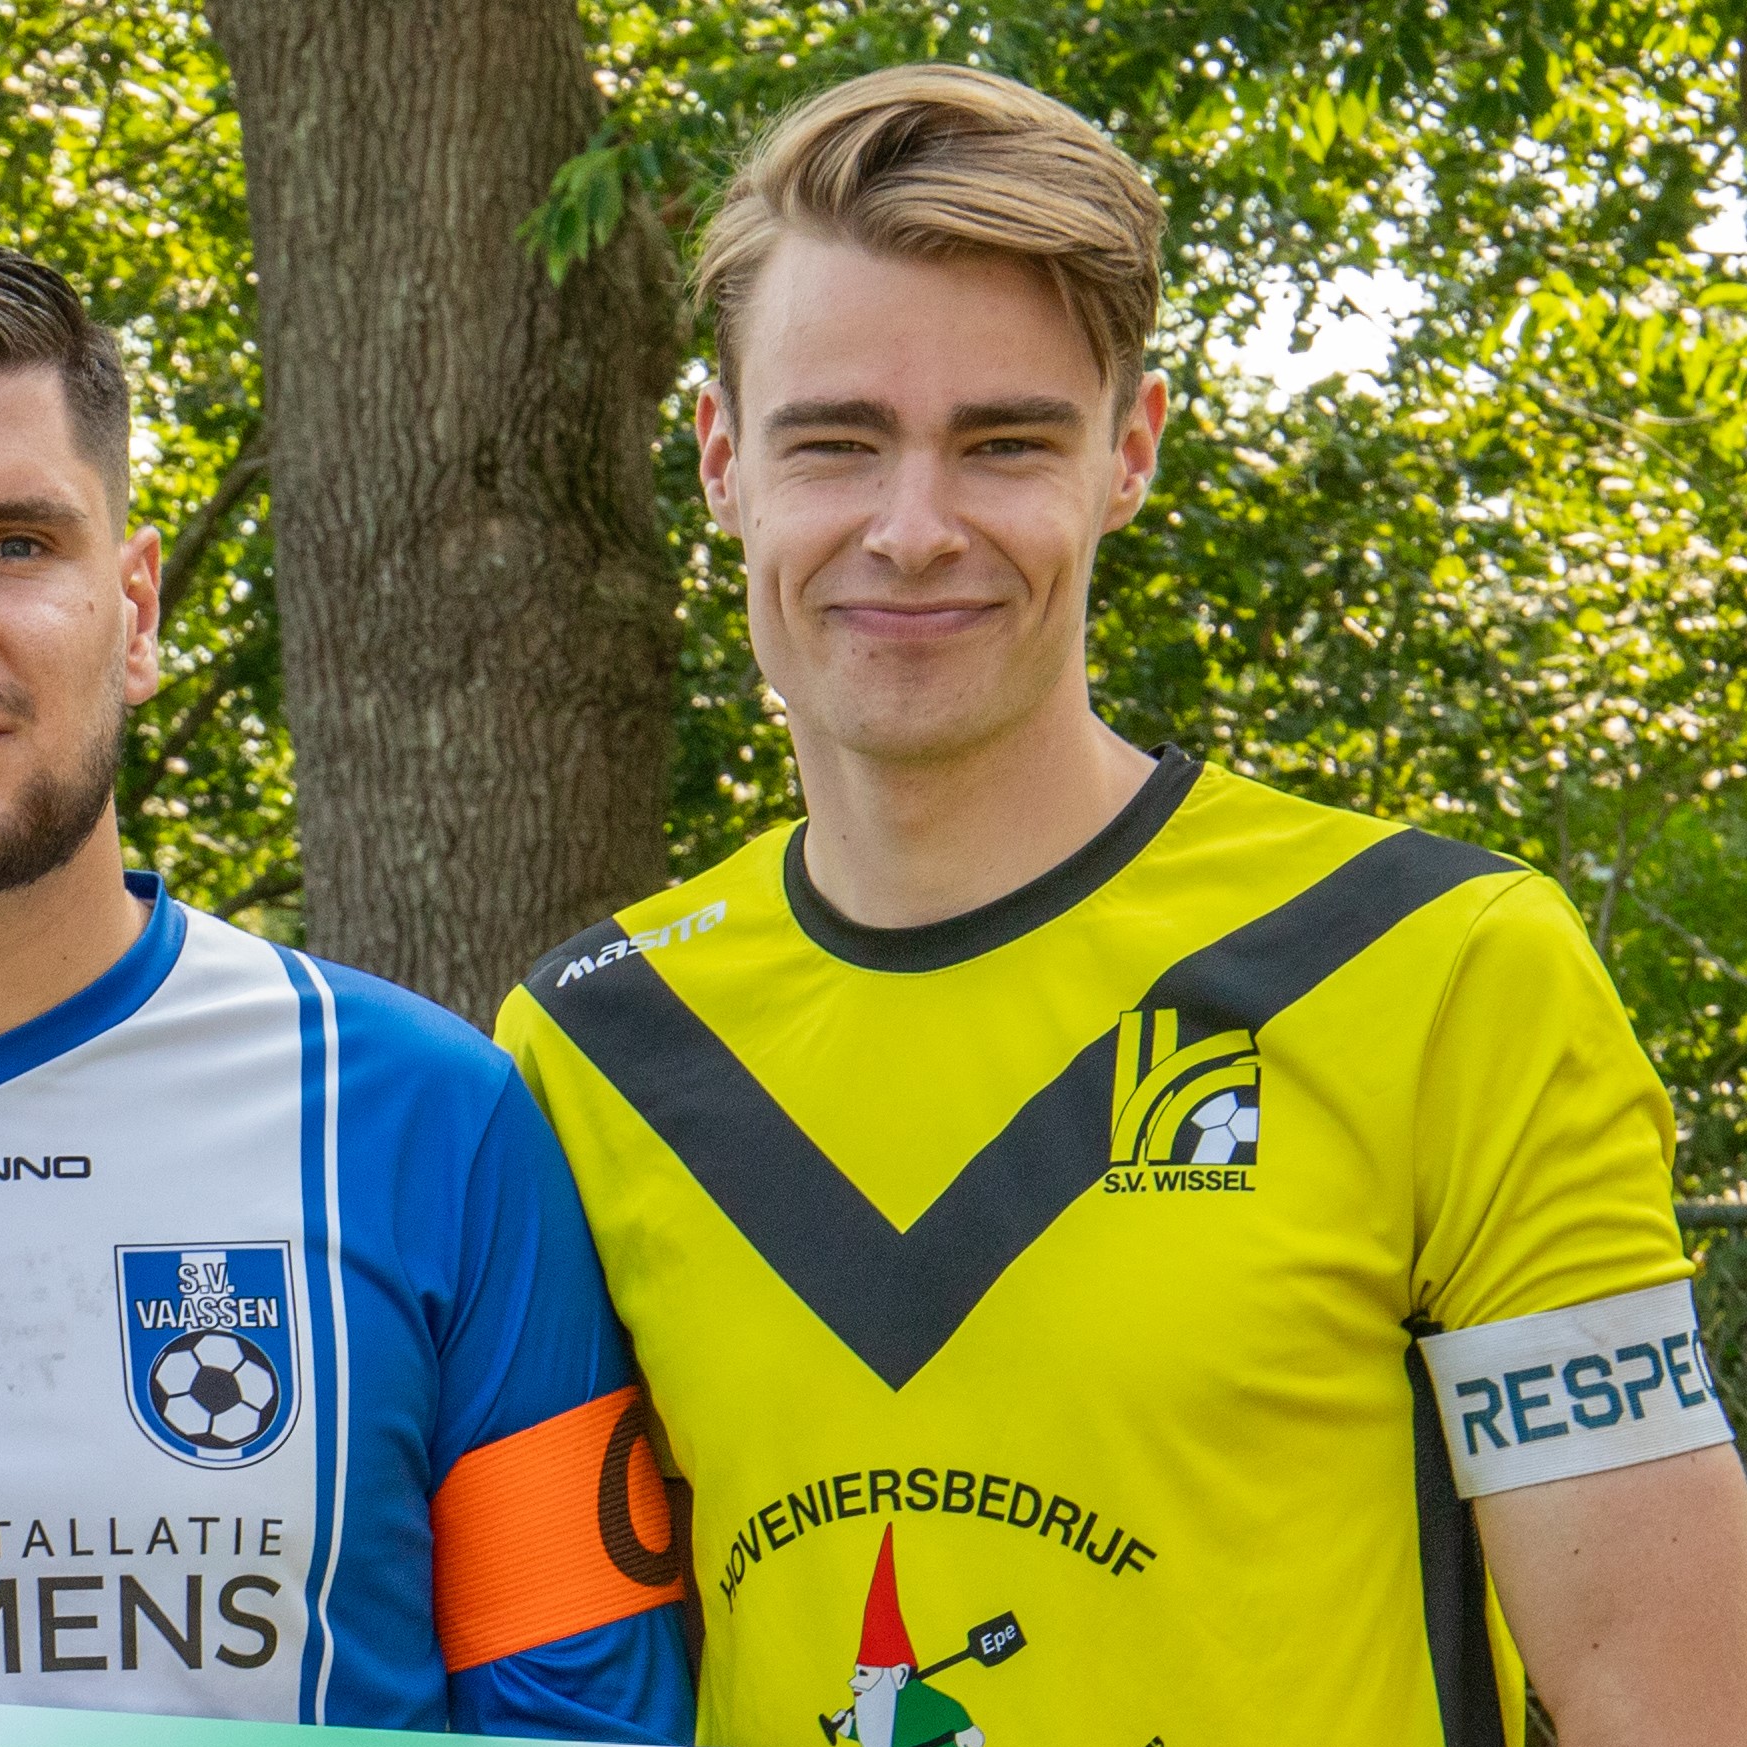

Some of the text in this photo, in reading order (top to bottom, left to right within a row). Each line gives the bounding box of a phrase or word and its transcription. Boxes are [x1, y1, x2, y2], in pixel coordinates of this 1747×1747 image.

[1103, 1170, 1257, 1194] S.V. WISSEL
[177, 1262, 236, 1294] S.V.
[135, 1297, 281, 1330] VAASSEN
[719, 1467, 1158, 1615] HOVENIERSBEDRIJF
[980, 1621, 1017, 1655] Epe
